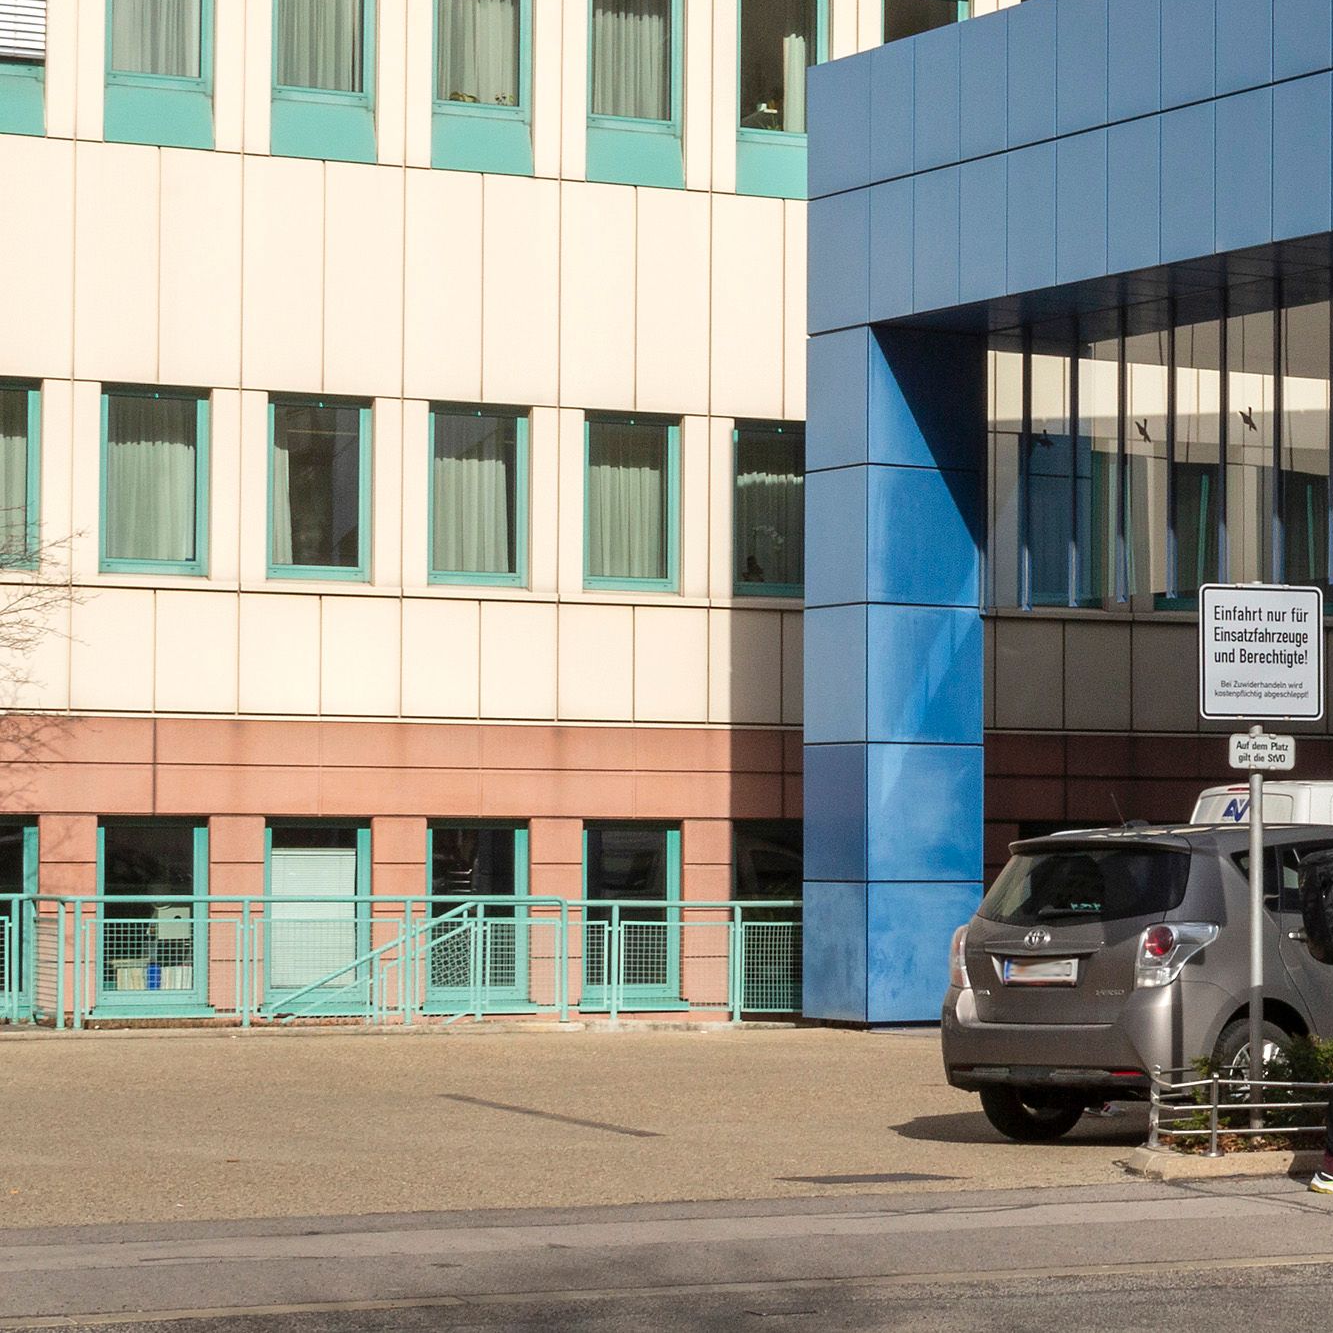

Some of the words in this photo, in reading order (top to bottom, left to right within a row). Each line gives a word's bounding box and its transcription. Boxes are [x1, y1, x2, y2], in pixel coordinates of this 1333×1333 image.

[1214, 605, 1263, 622] Einfahrt
[1266, 610, 1287, 623] nur
[1291, 607, 1309, 623] für
[1213, 626, 1309, 647] Einsatzfahrzeuge
[1214, 648, 1235, 664] und
[1239, 649, 1308, 668] Berechtigte!
[1220, 680, 1232, 689] Bei
[1233, 680, 1287, 690] Zuwiderhandeln
[1288, 681, 1304, 690] wird
[1214, 689, 1263, 699] kostenpflichtig
[1263, 690, 1309, 700] abgeschleppt!
[1236, 741, 1250, 751] Auf
[1251, 741, 1268, 751] dem
[1270, 742, 1289, 752] Platz
[1238, 753, 1251, 763] gilt
[1253, 753, 1265, 763] die
[1267, 753, 1286, 763] StVO
